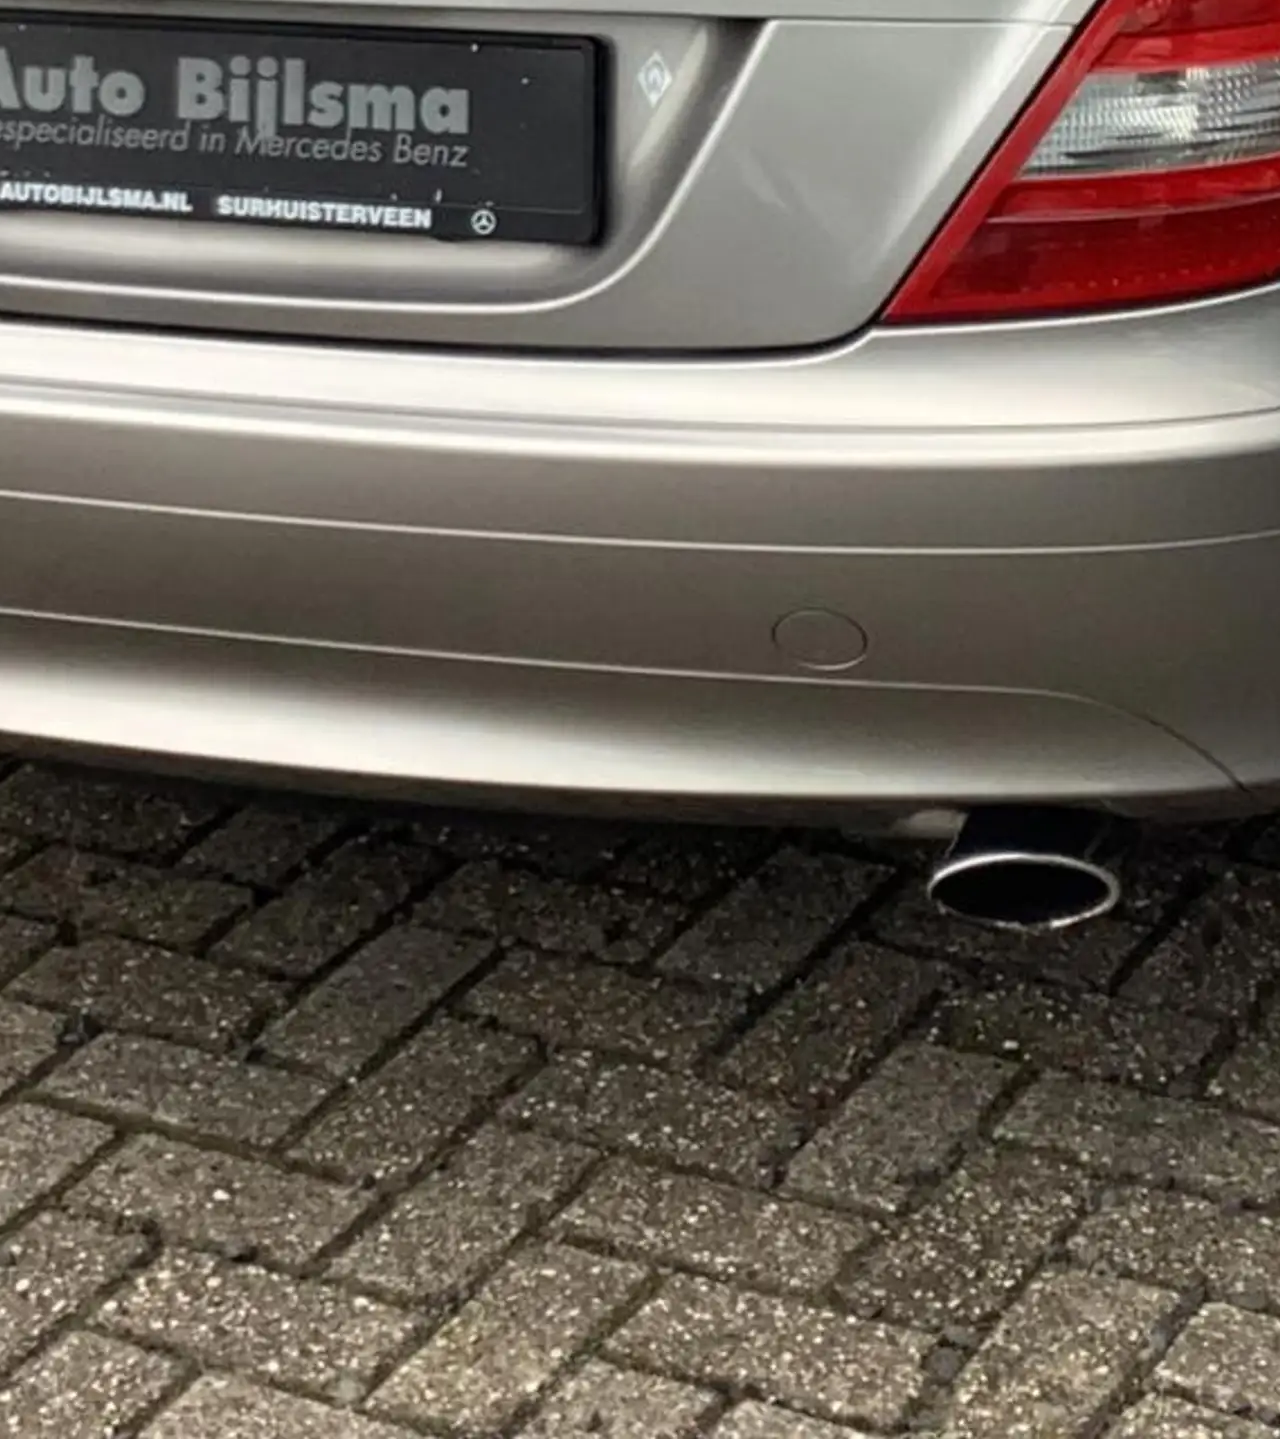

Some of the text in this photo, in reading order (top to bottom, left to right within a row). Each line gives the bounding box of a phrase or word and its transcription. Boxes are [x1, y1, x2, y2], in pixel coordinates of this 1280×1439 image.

[176, 55, 470, 139] Bijlsma
[198, 123, 226, 154] in
[233, 125, 383, 162] Mercedes
[392, 133, 470, 168] Benz
[215, 195, 433, 229] SURHUISTERVEEN
